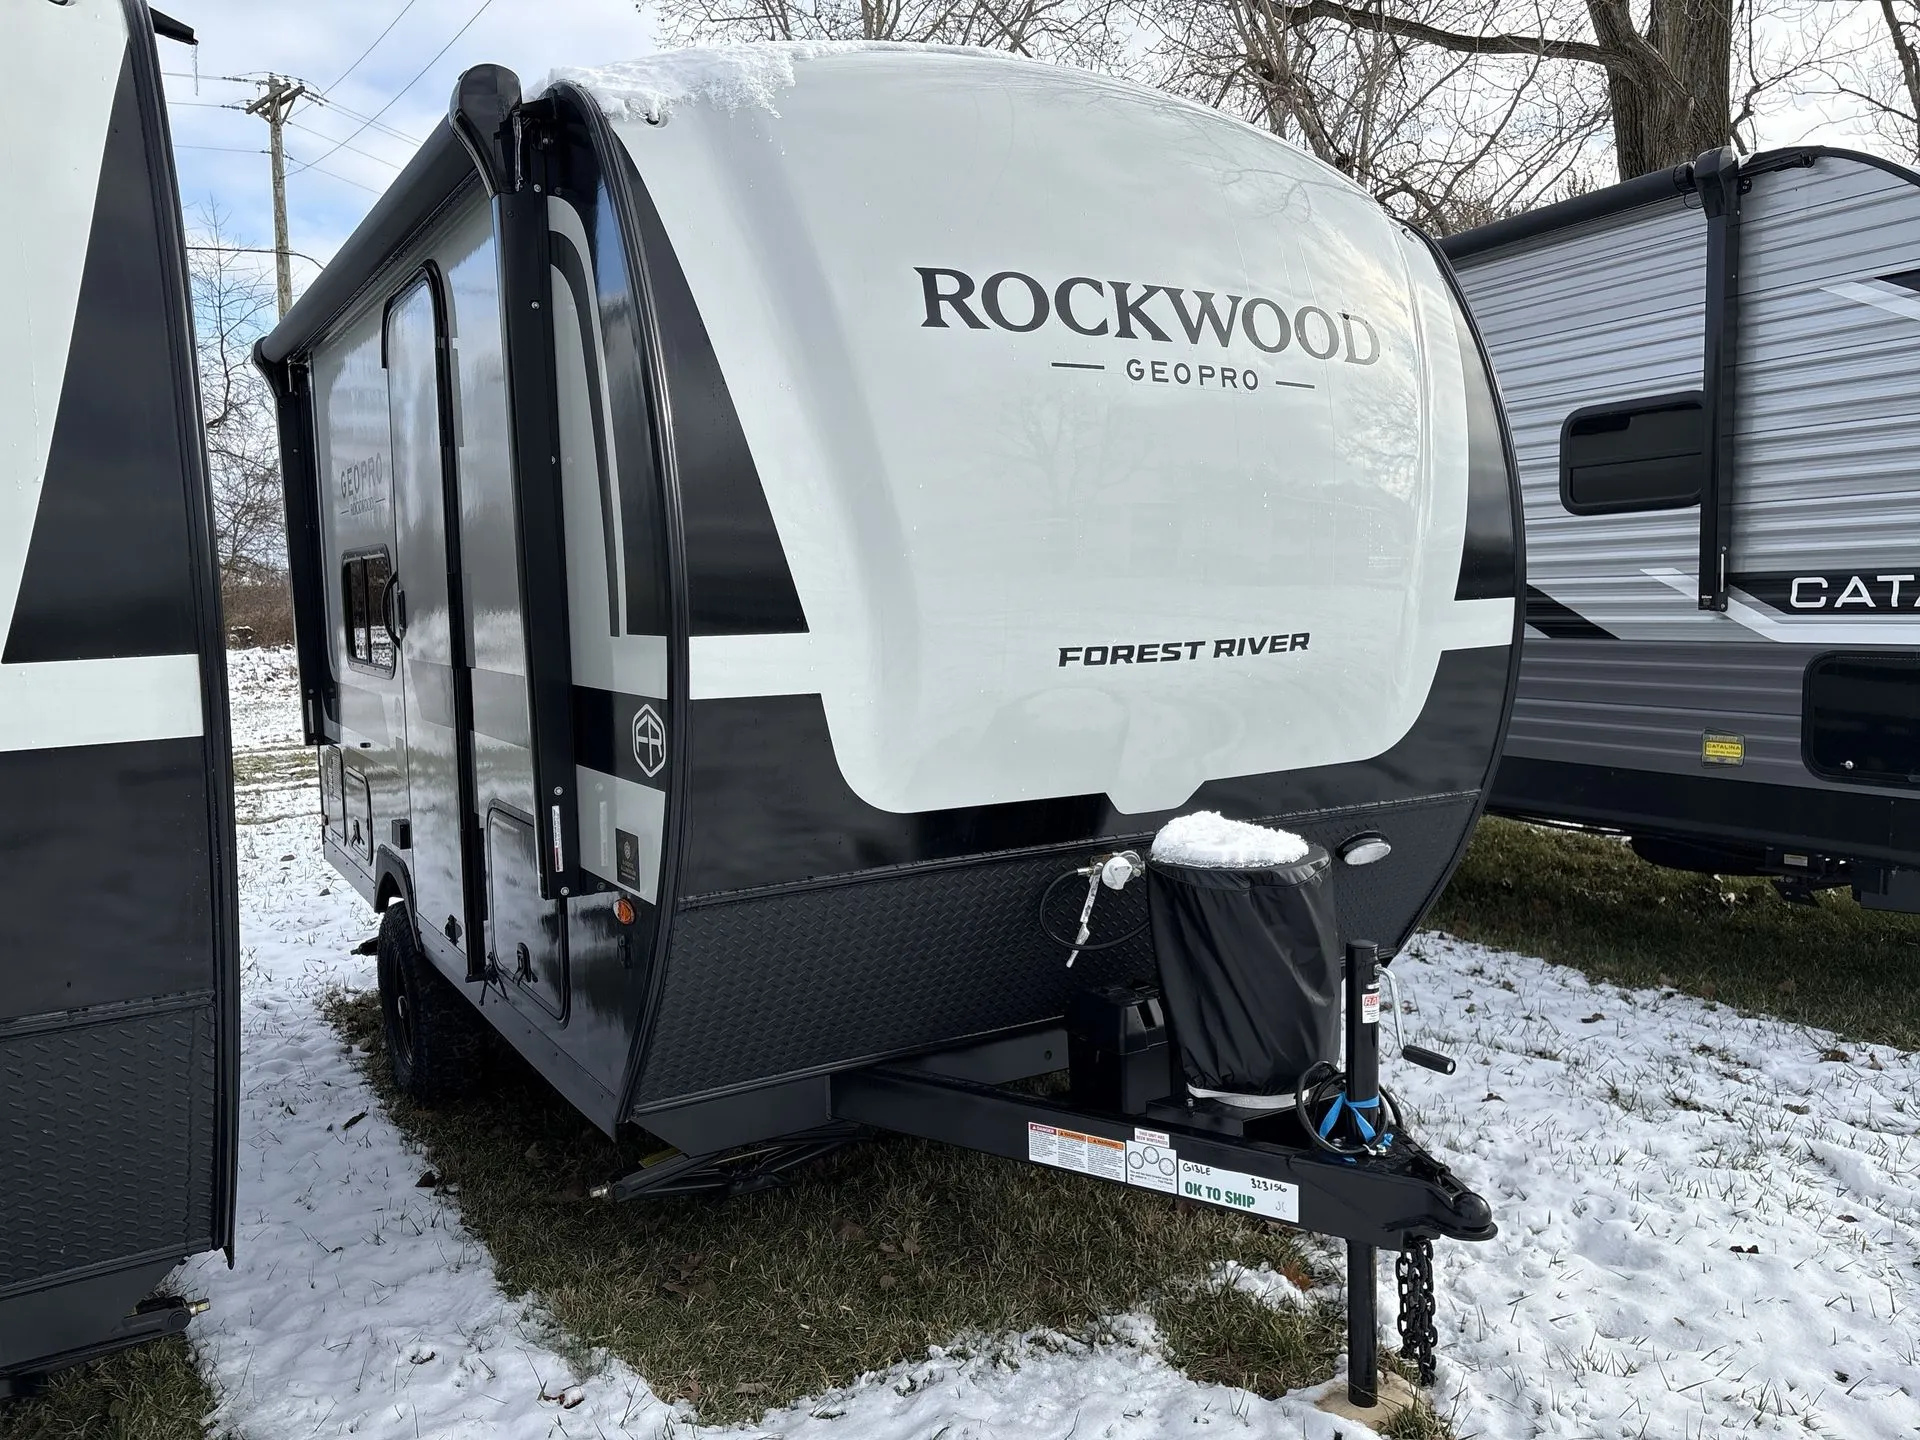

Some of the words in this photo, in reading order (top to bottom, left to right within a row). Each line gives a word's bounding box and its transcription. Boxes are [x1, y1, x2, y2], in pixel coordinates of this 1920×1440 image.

[913, 266, 1381, 366] ROCKWOOD
[1126, 358, 1259, 391] GEOPRO
[340, 452, 383, 499] GEOPRO
[1790, 574, 1920, 608] CAT
[1058, 640, 1206, 667] FOREST
[1213, 632, 1311, 659] RIVER
[1707, 743, 1741, 751] CATALINA
[1184, 1181, 1203, 1197] OK
[1205, 1186, 1221, 1201] TO
[1224, 1190, 1256, 1208] SHIP
[1250, 1177, 1288, 1193] 323156
